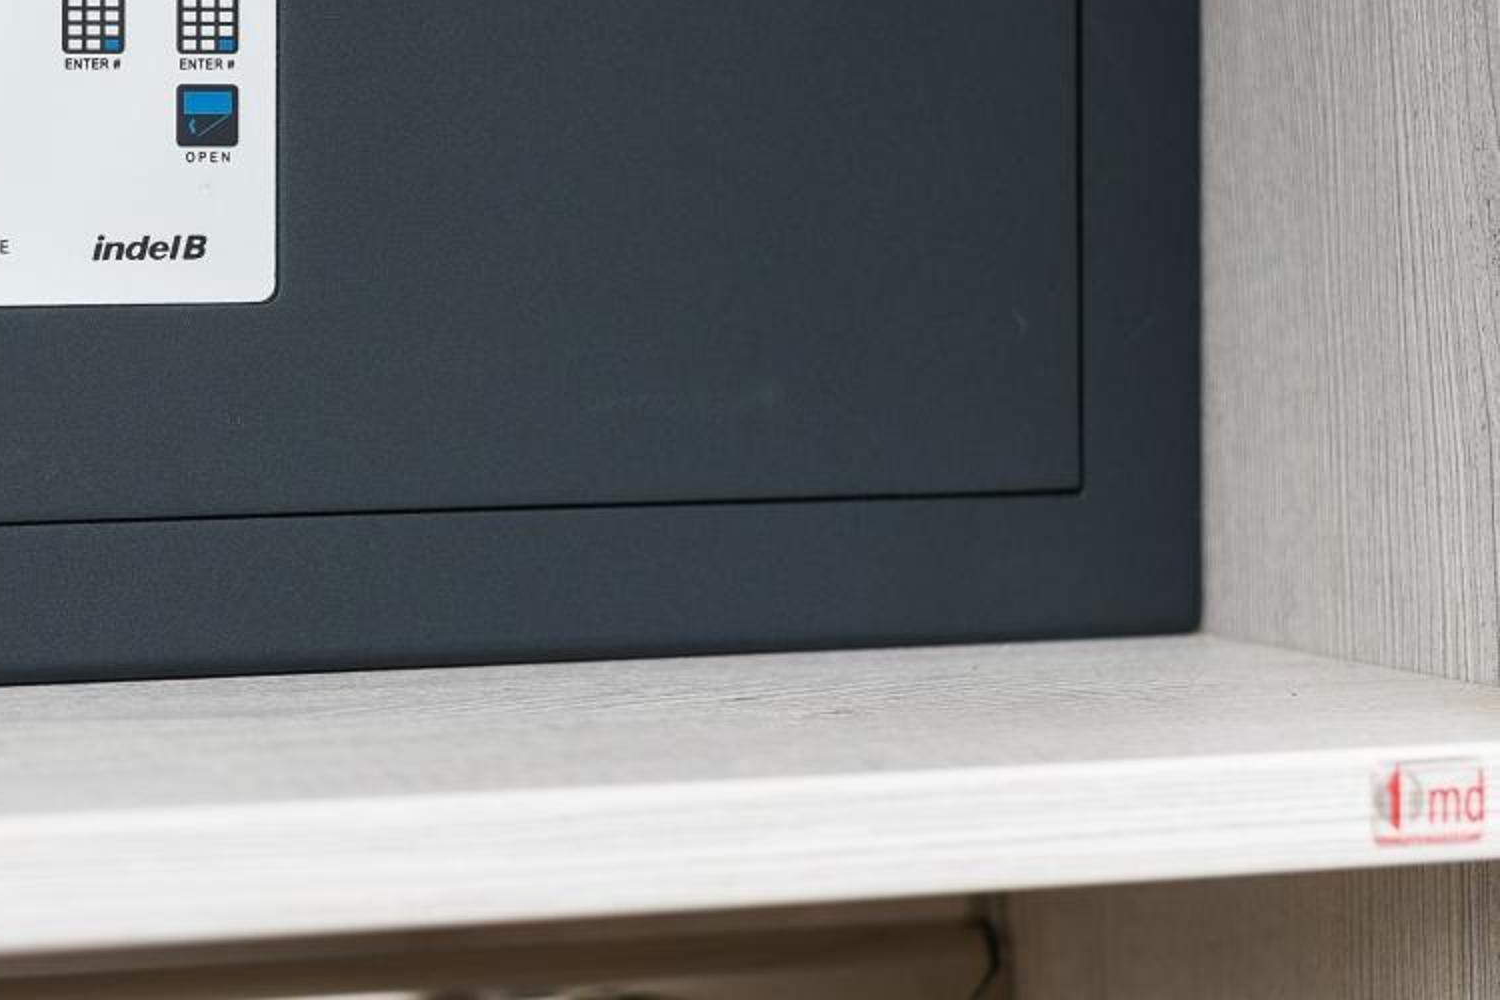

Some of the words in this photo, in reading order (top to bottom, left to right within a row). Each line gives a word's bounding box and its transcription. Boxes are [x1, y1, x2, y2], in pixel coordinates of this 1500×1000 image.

[65, 58, 109, 70] ENTER
[113, 58, 121, 70] #
[179, 58, 224, 70] ENTER
[227, 58, 236, 70] #
[185, 151, 231, 163] OPEN
[0, 239, 10, 254] E
